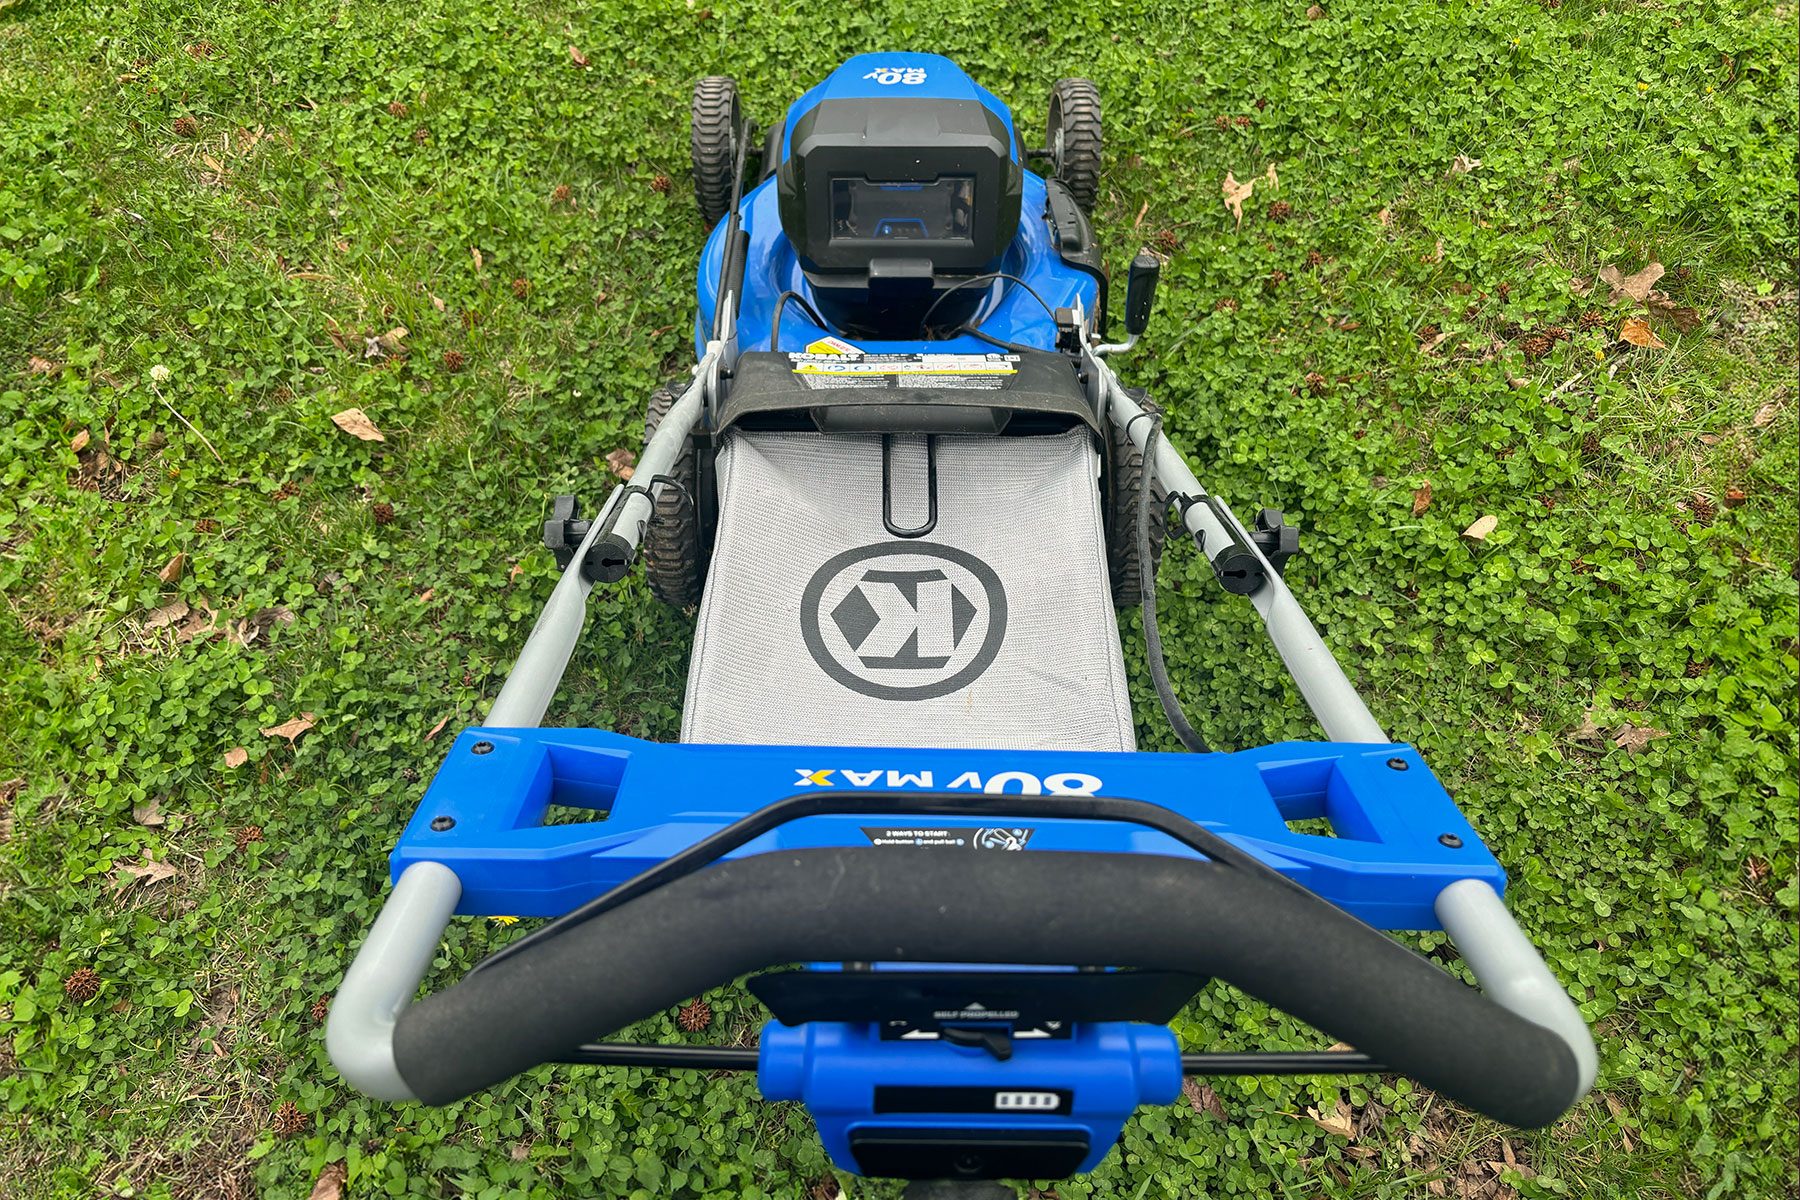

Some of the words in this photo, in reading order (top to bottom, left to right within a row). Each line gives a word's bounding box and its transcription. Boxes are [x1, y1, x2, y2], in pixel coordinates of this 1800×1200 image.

[794, 769, 934, 787] MAX
[934, 1011, 960, 1019] SELF
[960, 1011, 1020, 1019] PROPELLED
